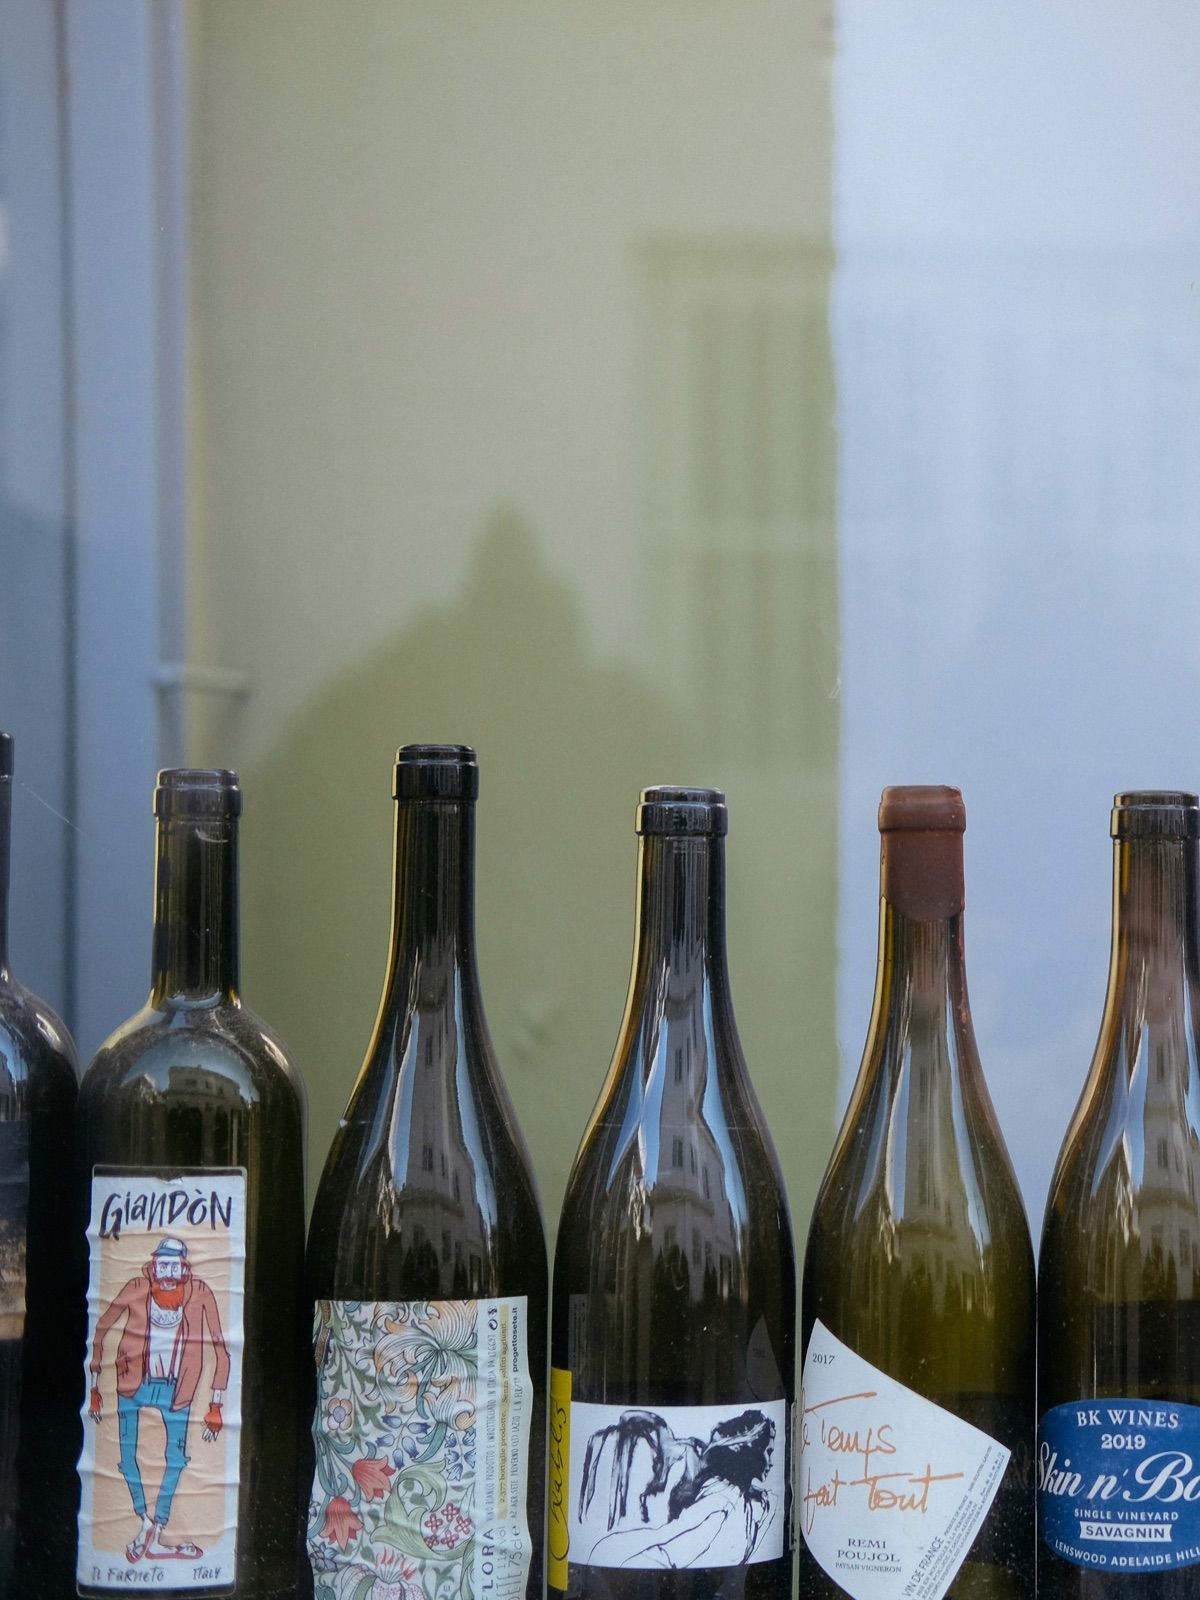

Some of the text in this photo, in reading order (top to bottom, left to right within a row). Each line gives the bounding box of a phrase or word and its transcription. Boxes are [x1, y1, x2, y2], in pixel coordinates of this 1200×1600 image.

[511, 1306, 519, 1373] progettosete.it
[812, 1353, 835, 1365] 2017
[1077, 1409, 1180, 1429] BK WINES
[1100, 1433, 1147, 1450] 2019
[1074, 1508, 1179, 1521] SINGLE VINEYARD
[1085, 1525, 1166, 1540] SAVAGNIN
[848, 1537, 887, 1549] REMI
[837, 1549, 900, 1562] POUJOL
[1055, 1540, 1107, 1565] LENSWOOD
[1110, 1554, 1172, 1567] ADELAIDE
[835, 1561, 902, 1574] PAYSAN VIGNERON
[901, 1581, 917, 1597] VIN
[911, 1568, 925, 1584] DE
[918, 1536, 944, 1570] FRANCE
